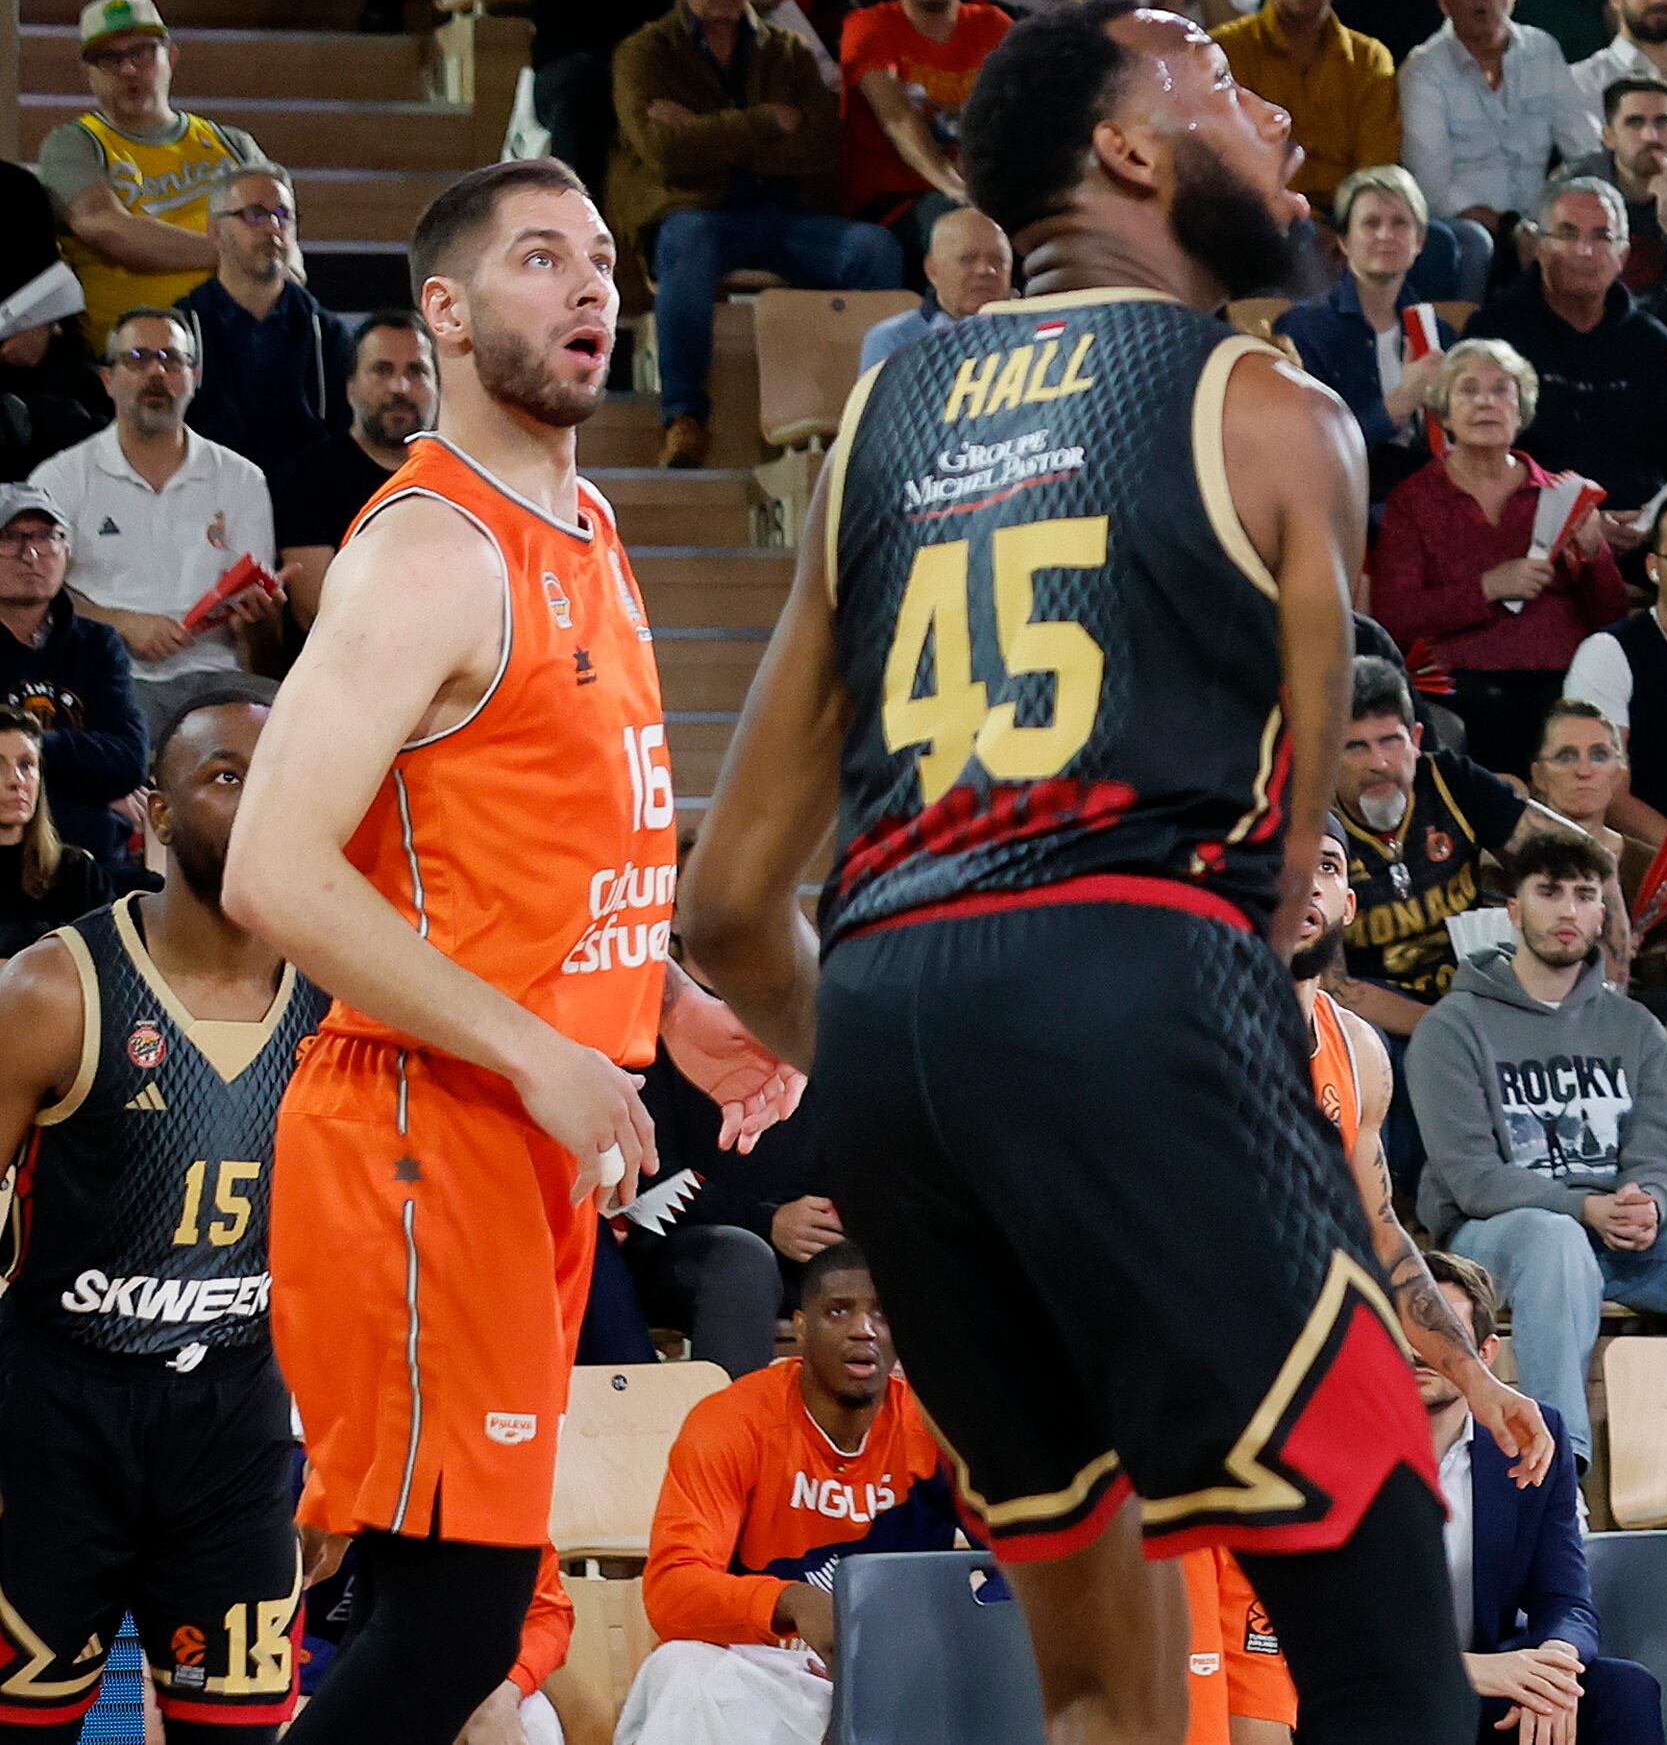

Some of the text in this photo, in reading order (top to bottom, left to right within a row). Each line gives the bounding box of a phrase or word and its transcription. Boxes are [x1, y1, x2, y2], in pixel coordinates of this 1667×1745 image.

[943, 333, 1096, 424] HALL
[881, 515, 1109, 806] 45
[623, 724, 674, 831] 16
[1496, 1056, 1623, 1106] ROCKY
[172, 1160, 262, 1247] 15
[61, 1268, 273, 1323] SKWEEK
